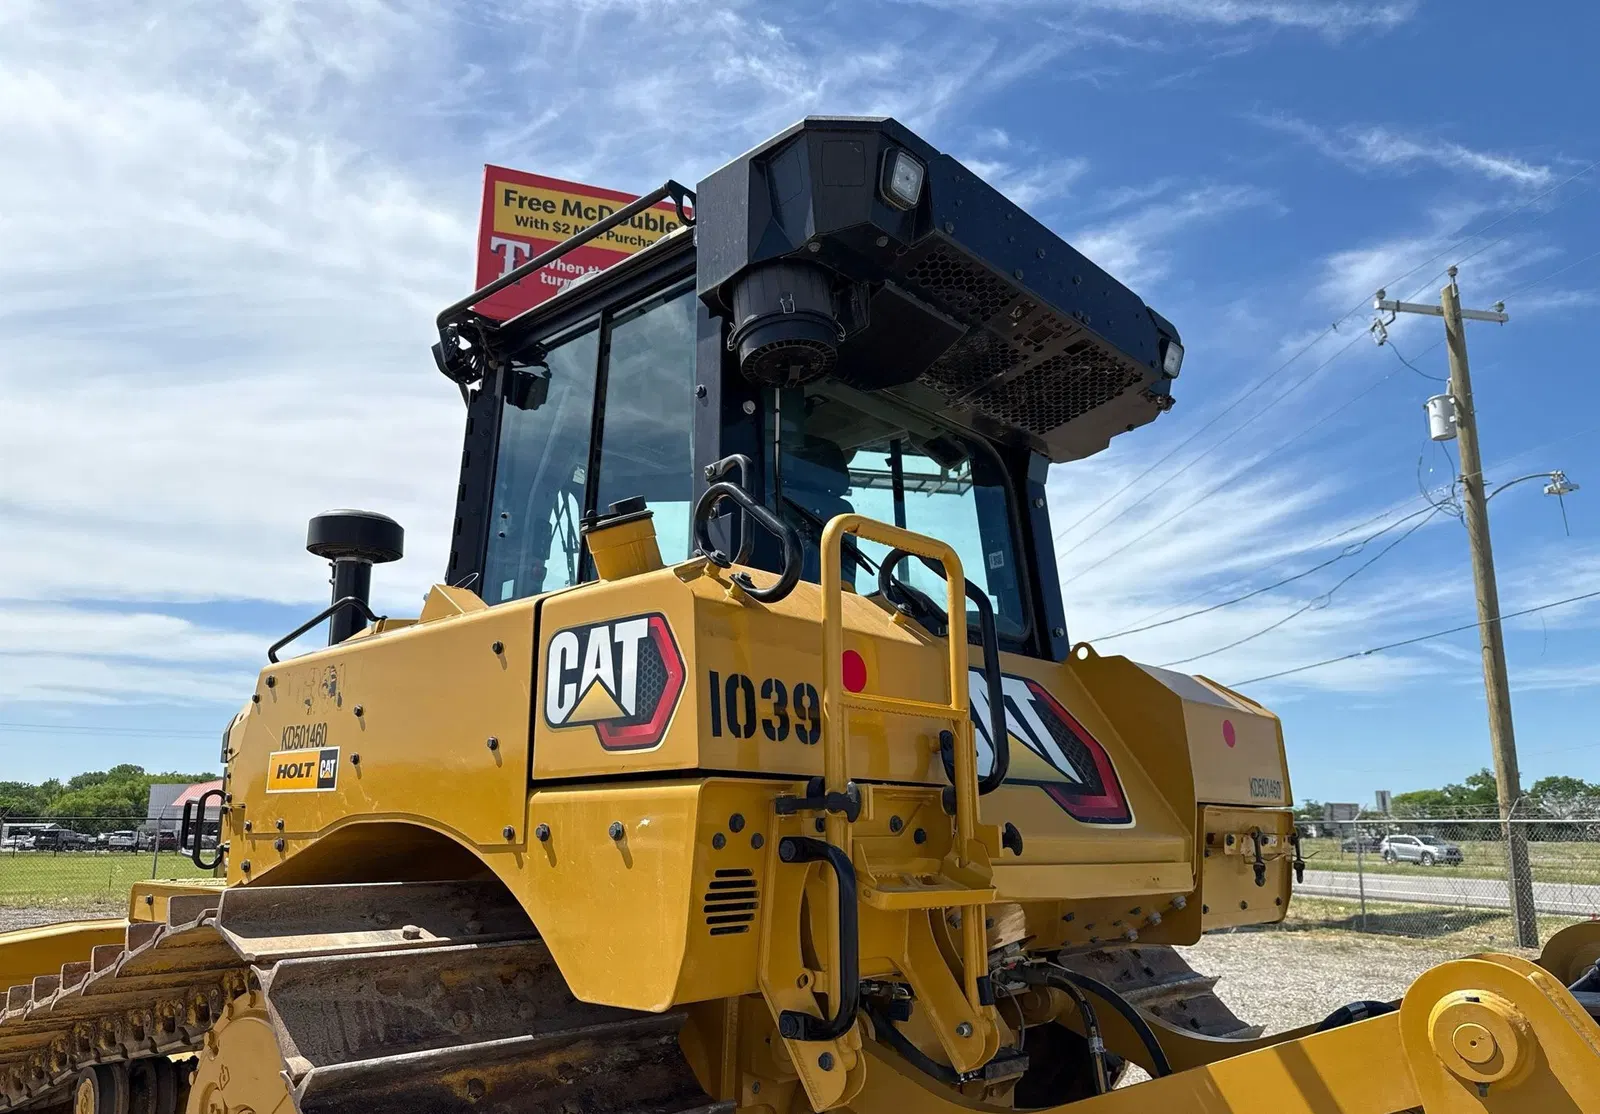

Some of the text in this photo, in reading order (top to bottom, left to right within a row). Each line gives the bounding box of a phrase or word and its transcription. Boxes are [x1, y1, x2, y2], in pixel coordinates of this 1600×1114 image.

[504, 188, 556, 214] Free
[515, 215, 549, 231] With
[552, 220, 570, 235] $2
[546, 617, 649, 724] CAT
[709, 670, 822, 746] 1039
[281, 722, 328, 750] KD501460
[276, 759, 336, 780] HOLT CAT
